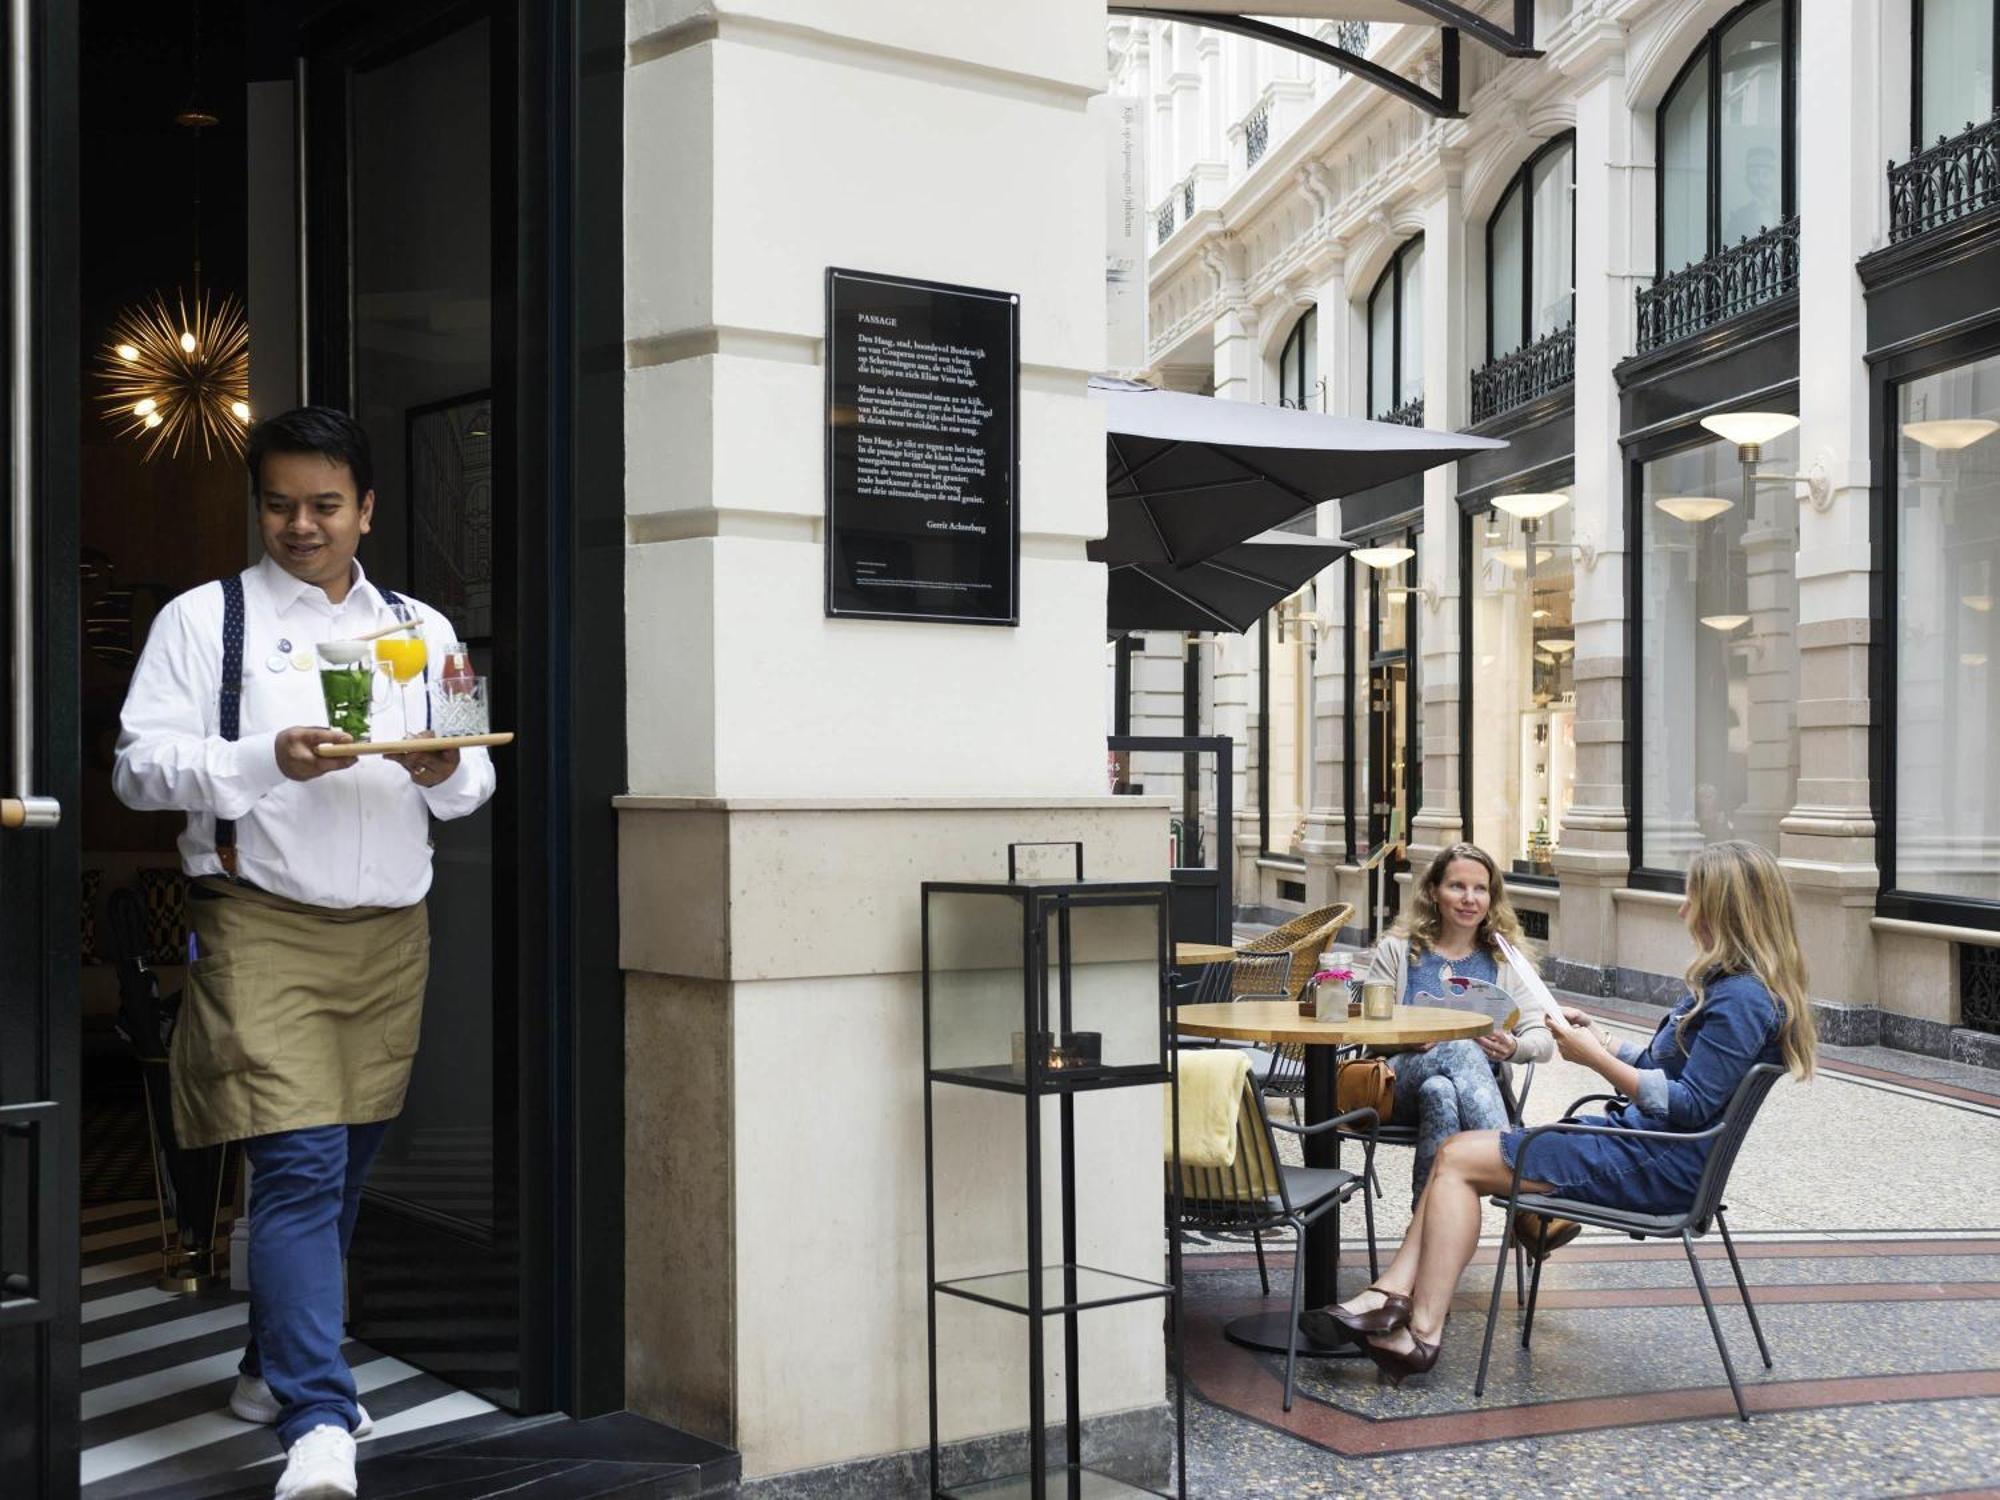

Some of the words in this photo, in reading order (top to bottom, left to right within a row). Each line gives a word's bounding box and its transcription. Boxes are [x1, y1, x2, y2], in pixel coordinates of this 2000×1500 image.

[858, 314, 897, 326] PASSAGE
[926, 520, 948, 529] Gerrit
[948, 522, 986, 534] Achterberg
